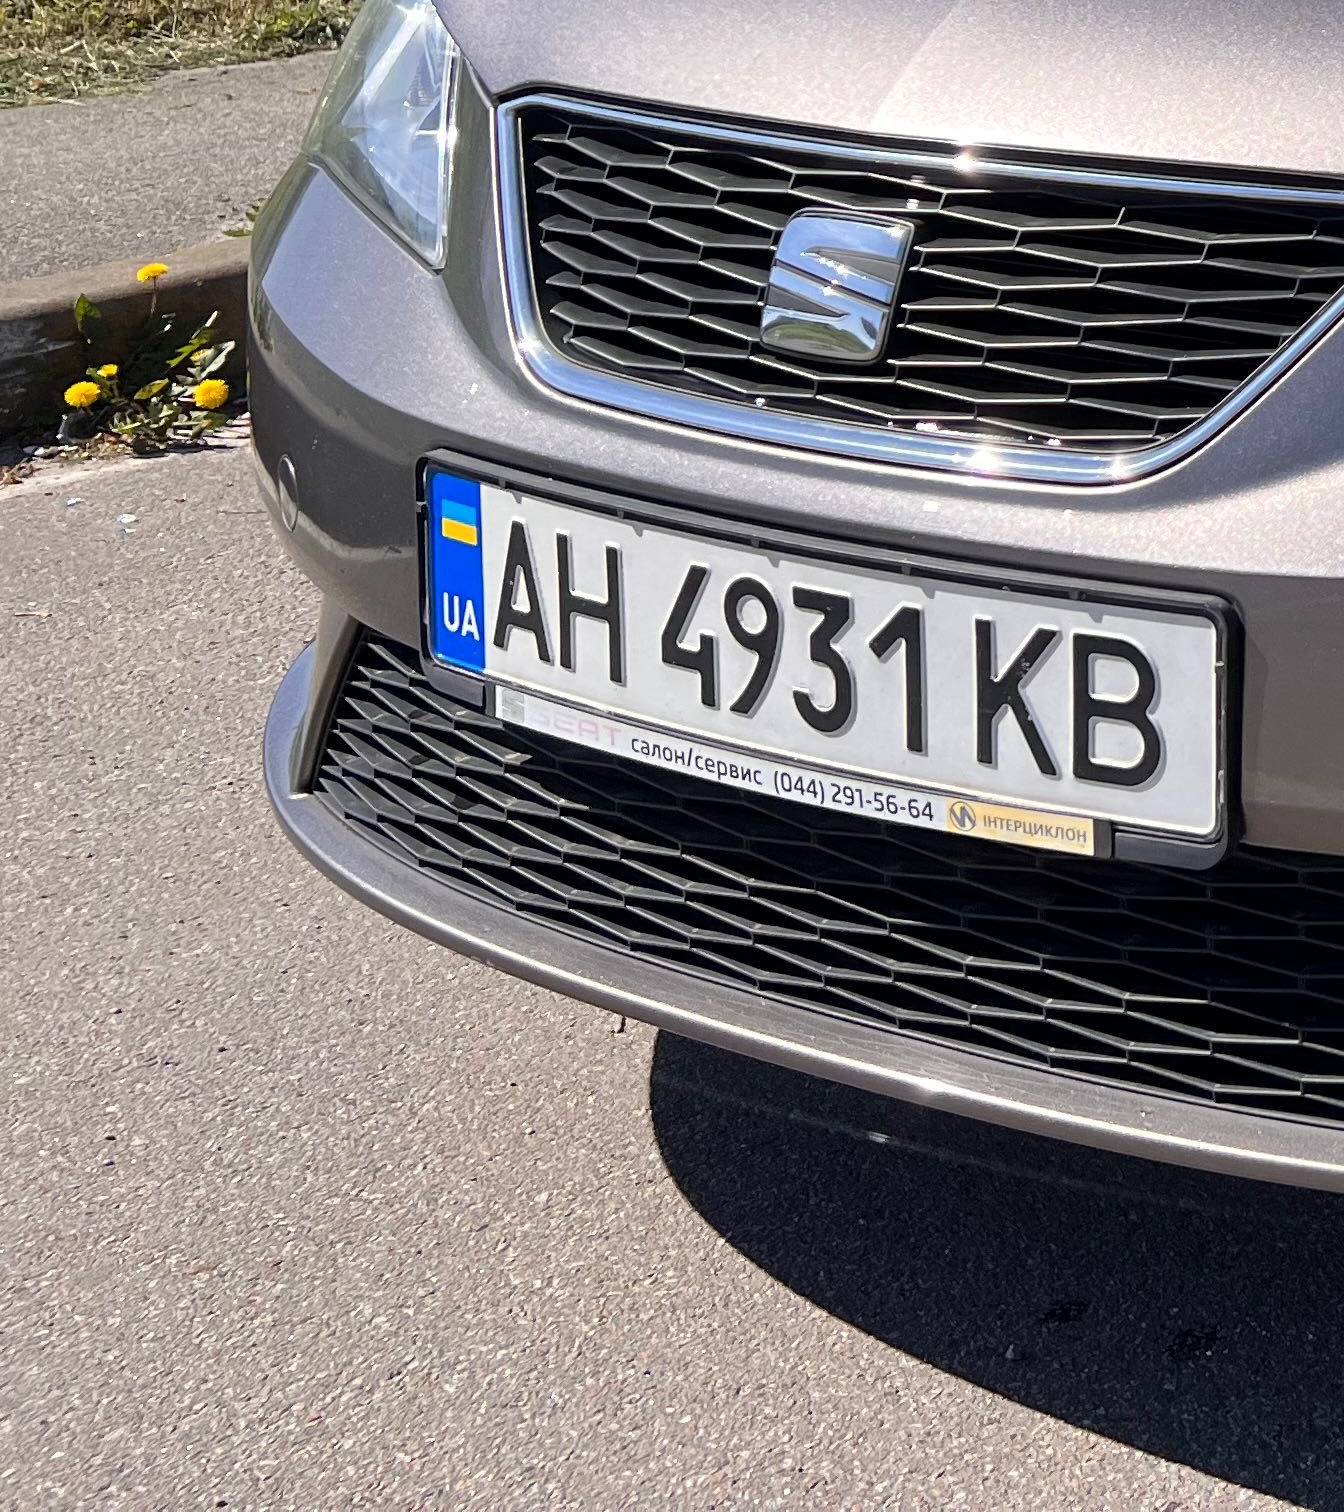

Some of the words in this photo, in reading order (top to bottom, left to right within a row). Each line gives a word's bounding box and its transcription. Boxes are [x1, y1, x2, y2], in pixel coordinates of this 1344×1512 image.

[443, 591, 480, 641] UA
[493, 519, 625, 686] AH
[661, 562, 924, 754] 4931
[975, 617, 1162, 786] KB
[631, 737, 763, 785] салон/сервис
[774, 770, 825, 805] (044)
[830, 782, 935, 822] 291-56-64
[983, 814, 1087, 843] ІНТЕРЦИКЛОН
